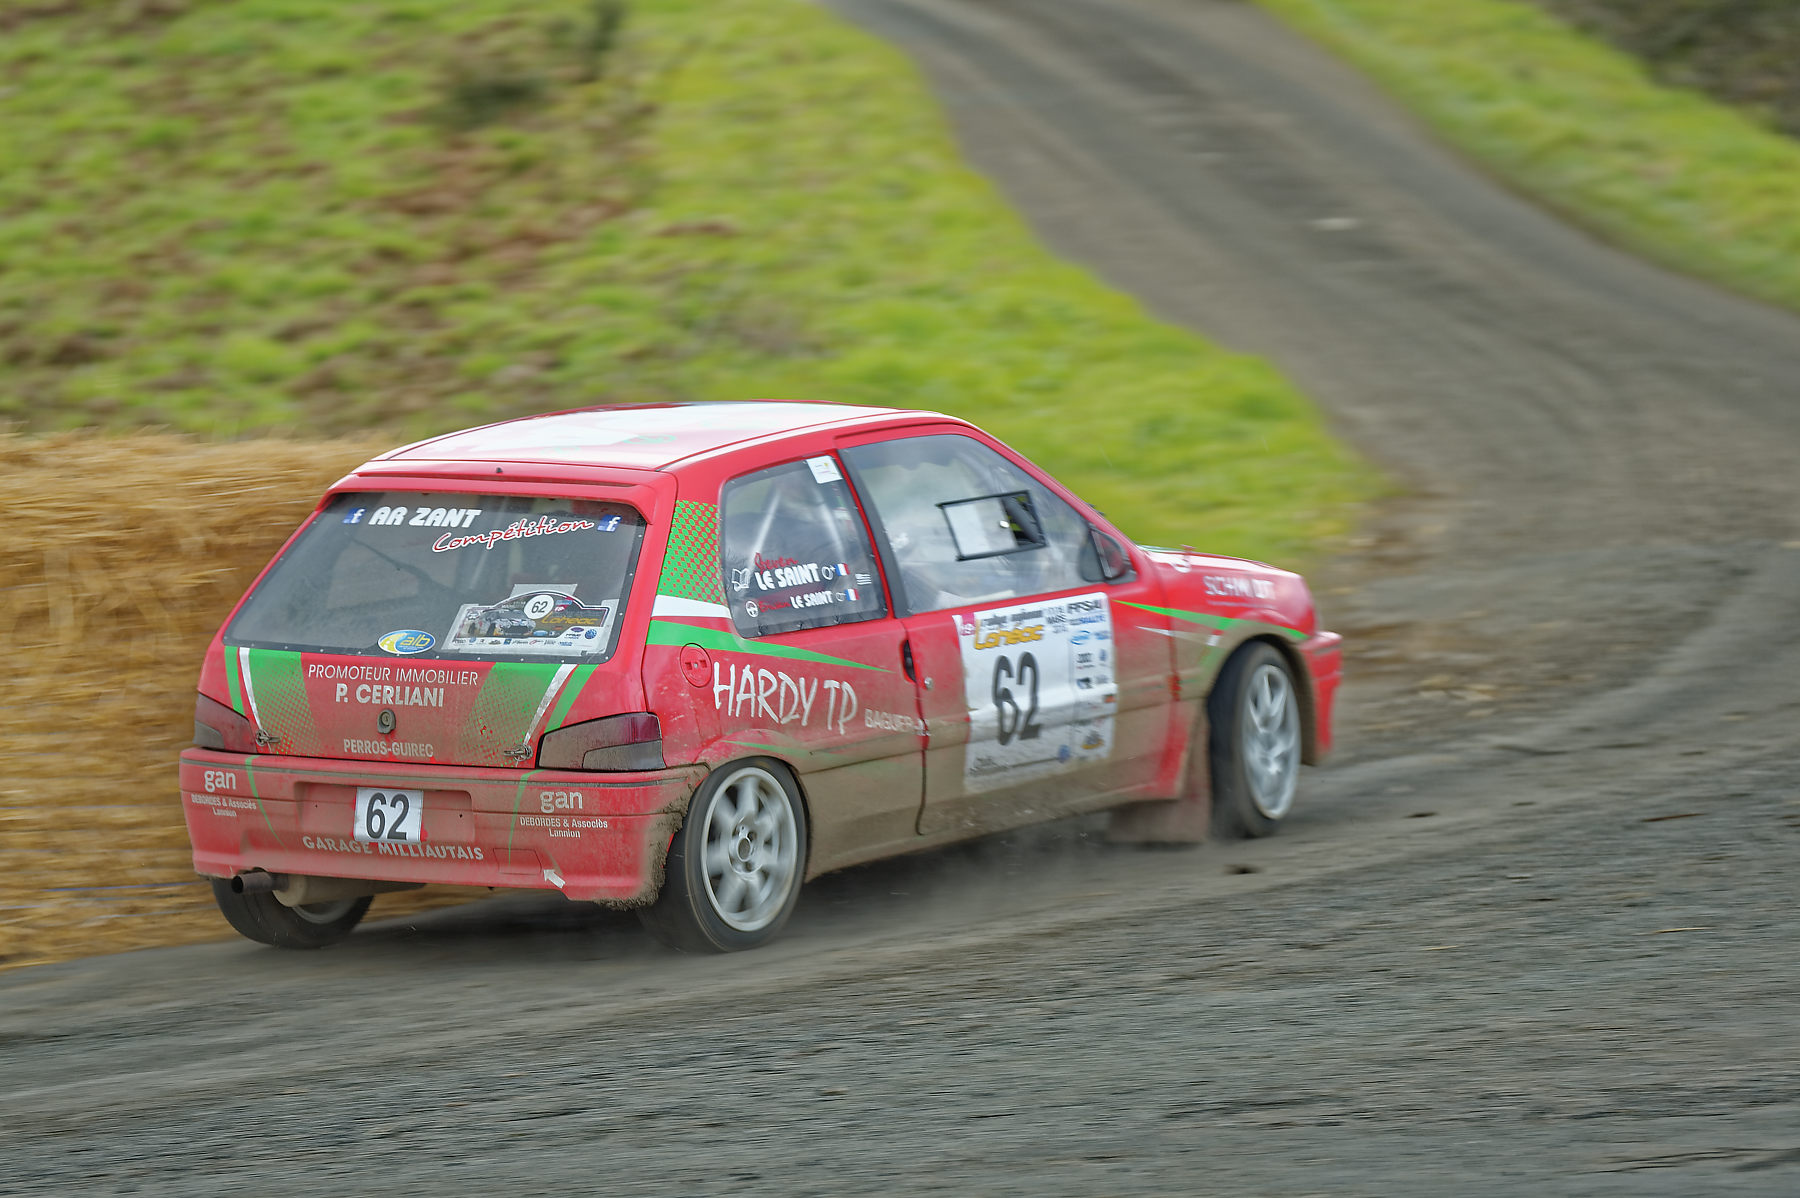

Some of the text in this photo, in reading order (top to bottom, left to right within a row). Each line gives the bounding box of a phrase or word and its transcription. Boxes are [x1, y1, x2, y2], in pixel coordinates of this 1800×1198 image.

[368, 506, 483, 528] AR ZANT
[432, 515, 595, 552] Compétition
[755, 563, 820, 590] LE SAINT
[531, 601, 548, 613] 62
[789, 590, 833, 609] LE SAINT
[400, 634, 431, 647] alb
[308, 664, 479, 686] PROMOTEUR IMMOBILIER
[335, 683, 445, 707] P. CERLIANI
[713, 661, 858, 735] HARDY TP
[992, 652, 1040, 746] 62
[344, 739, 434, 758] PERROS-GUIREC
[204, 770, 237, 792] gan
[540, 791, 583, 814] gan
[366, 792, 410, 840] 62
[519, 817, 561, 828] DEBORDES
[563, 819, 570, 828] &
[548, 828, 581, 838] Lannion
[302, 836, 484, 860] GARAGE MILLIAUTAIS
